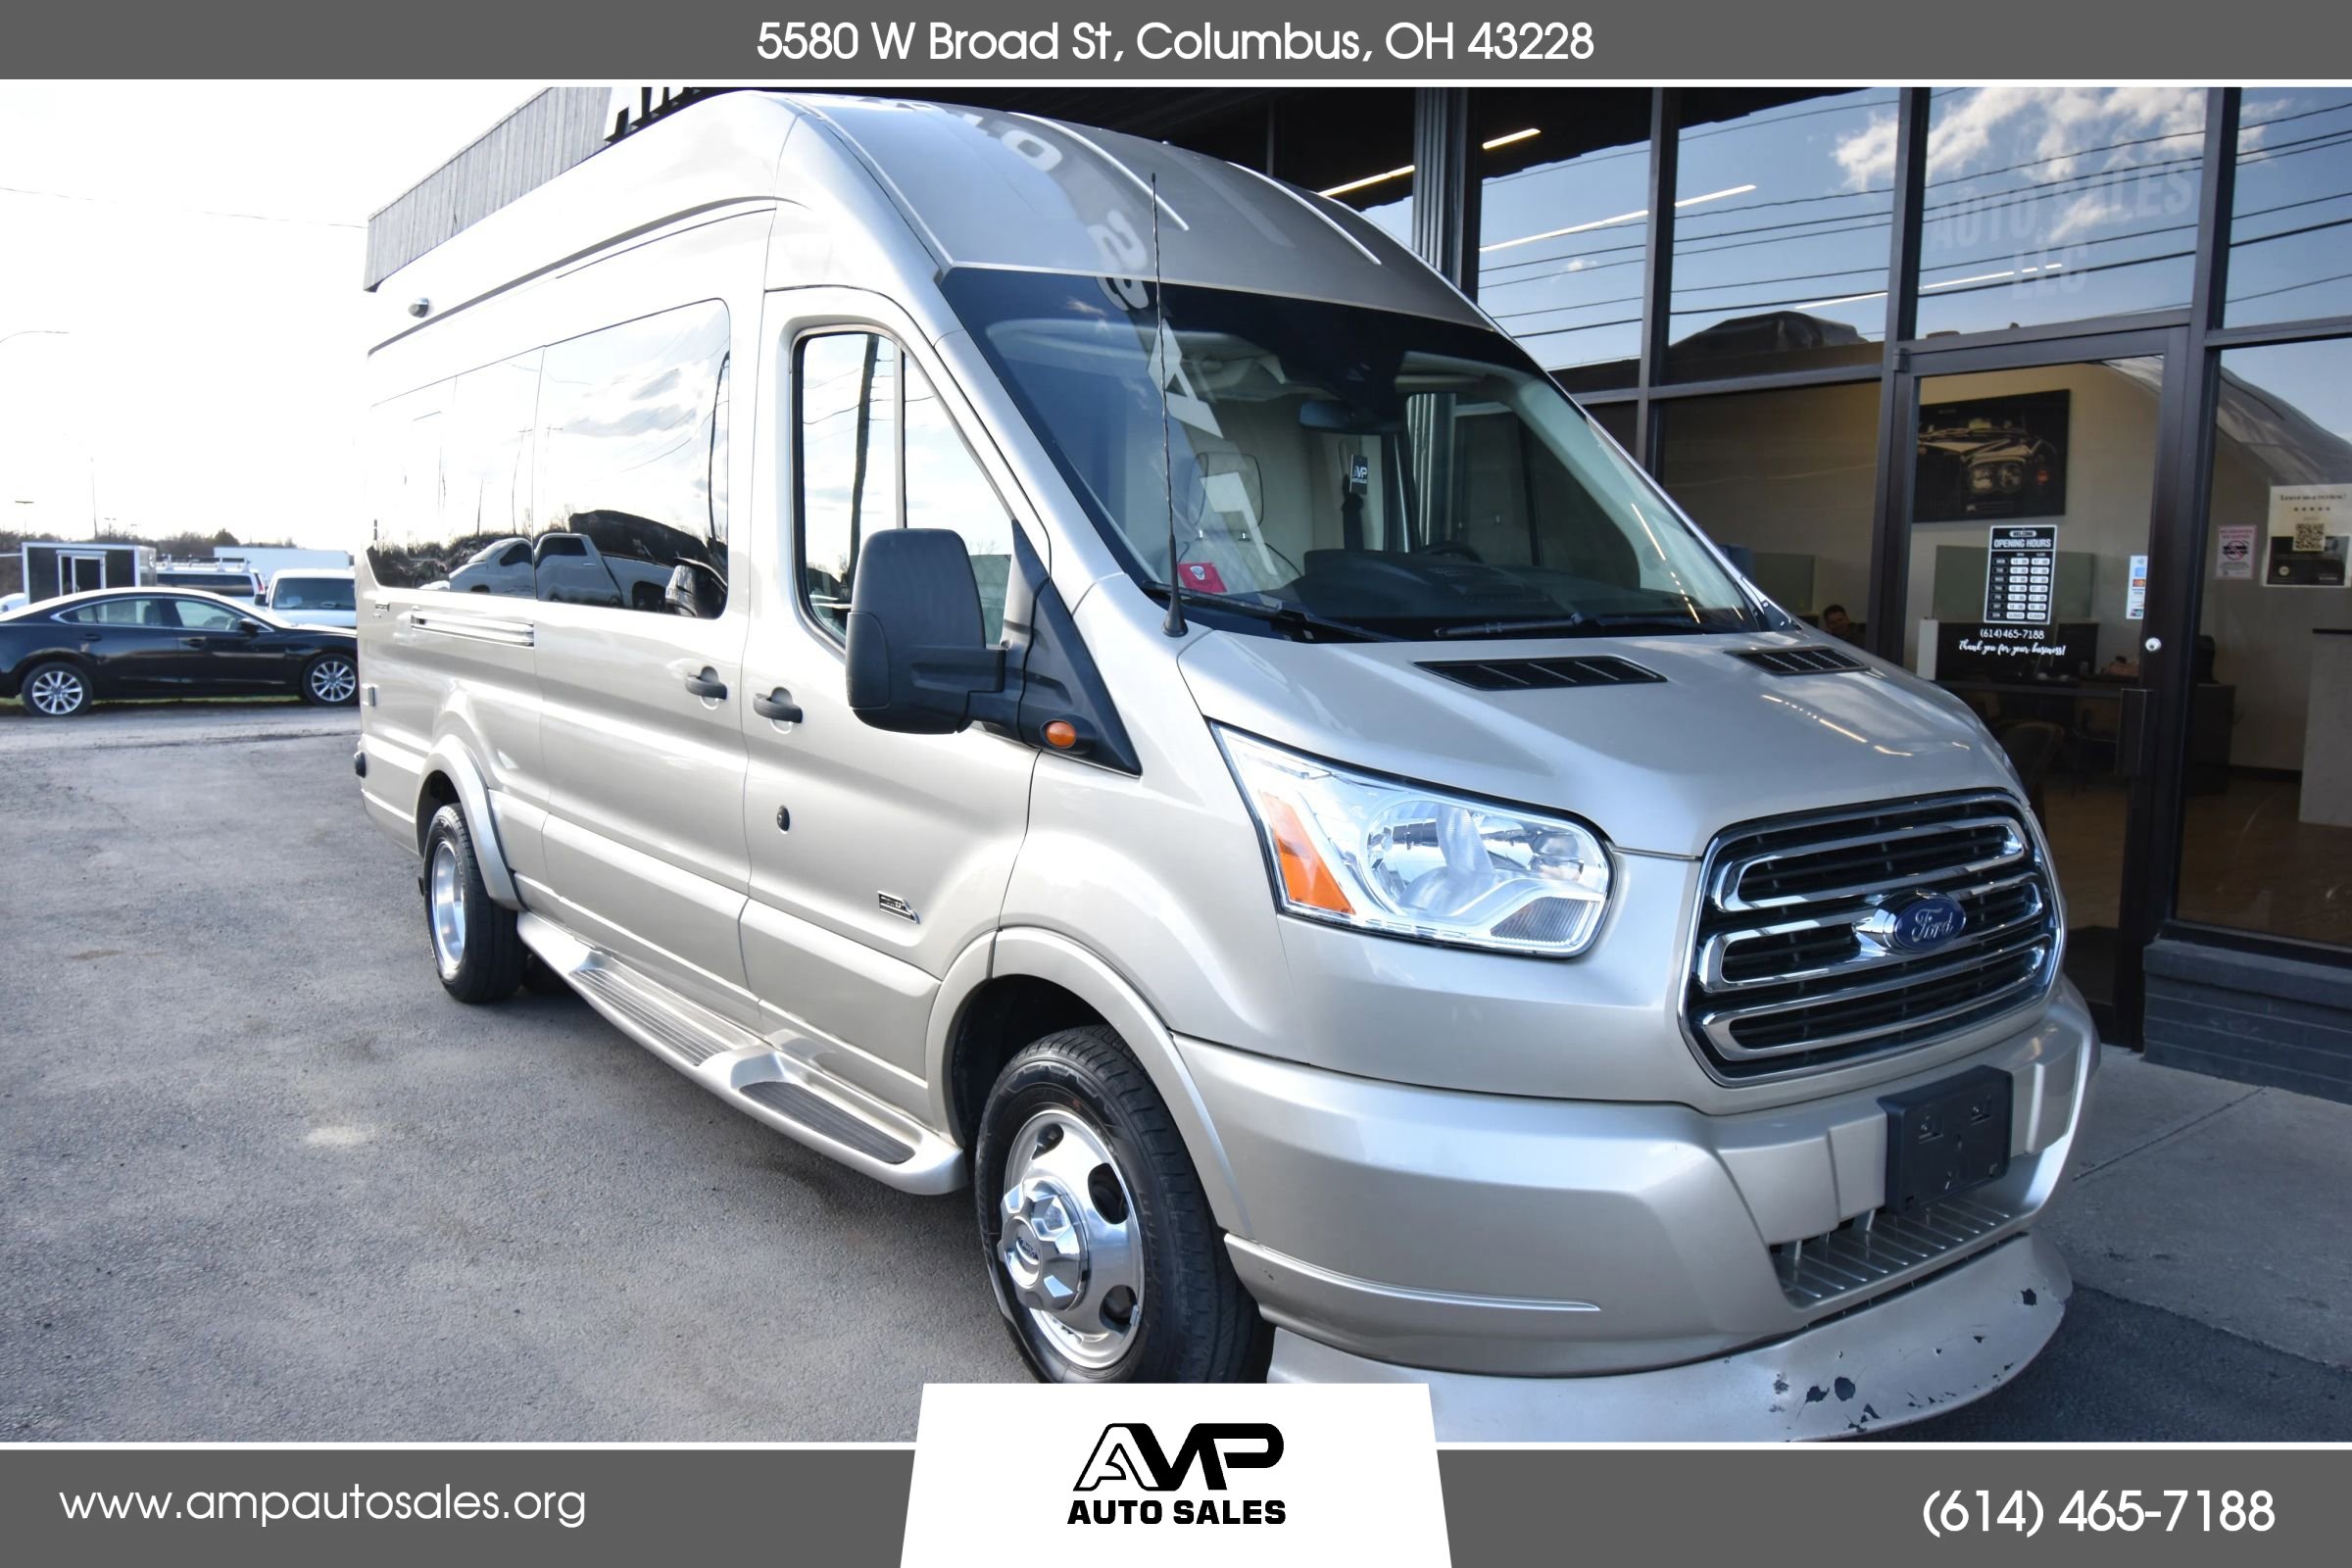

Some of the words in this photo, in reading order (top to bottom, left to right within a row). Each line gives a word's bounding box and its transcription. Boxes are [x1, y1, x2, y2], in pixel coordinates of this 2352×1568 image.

[1929, 191, 2038, 248] AUTO
[2053, 163, 2193, 232] SALES
[2012, 243, 2088, 299] LLC
[1993, 539, 2026, 548] OPENING
[2026, 538, 2052, 548] HOURS
[1959, 639, 1983, 651] Thank
[1983, 646, 1996, 656] you
[1997, 644, 2011, 656] for
[2010, 646, 2030, 656] your
[2032, 642, 2066, 656] business!
[1912, 907, 1953, 942] Ford
